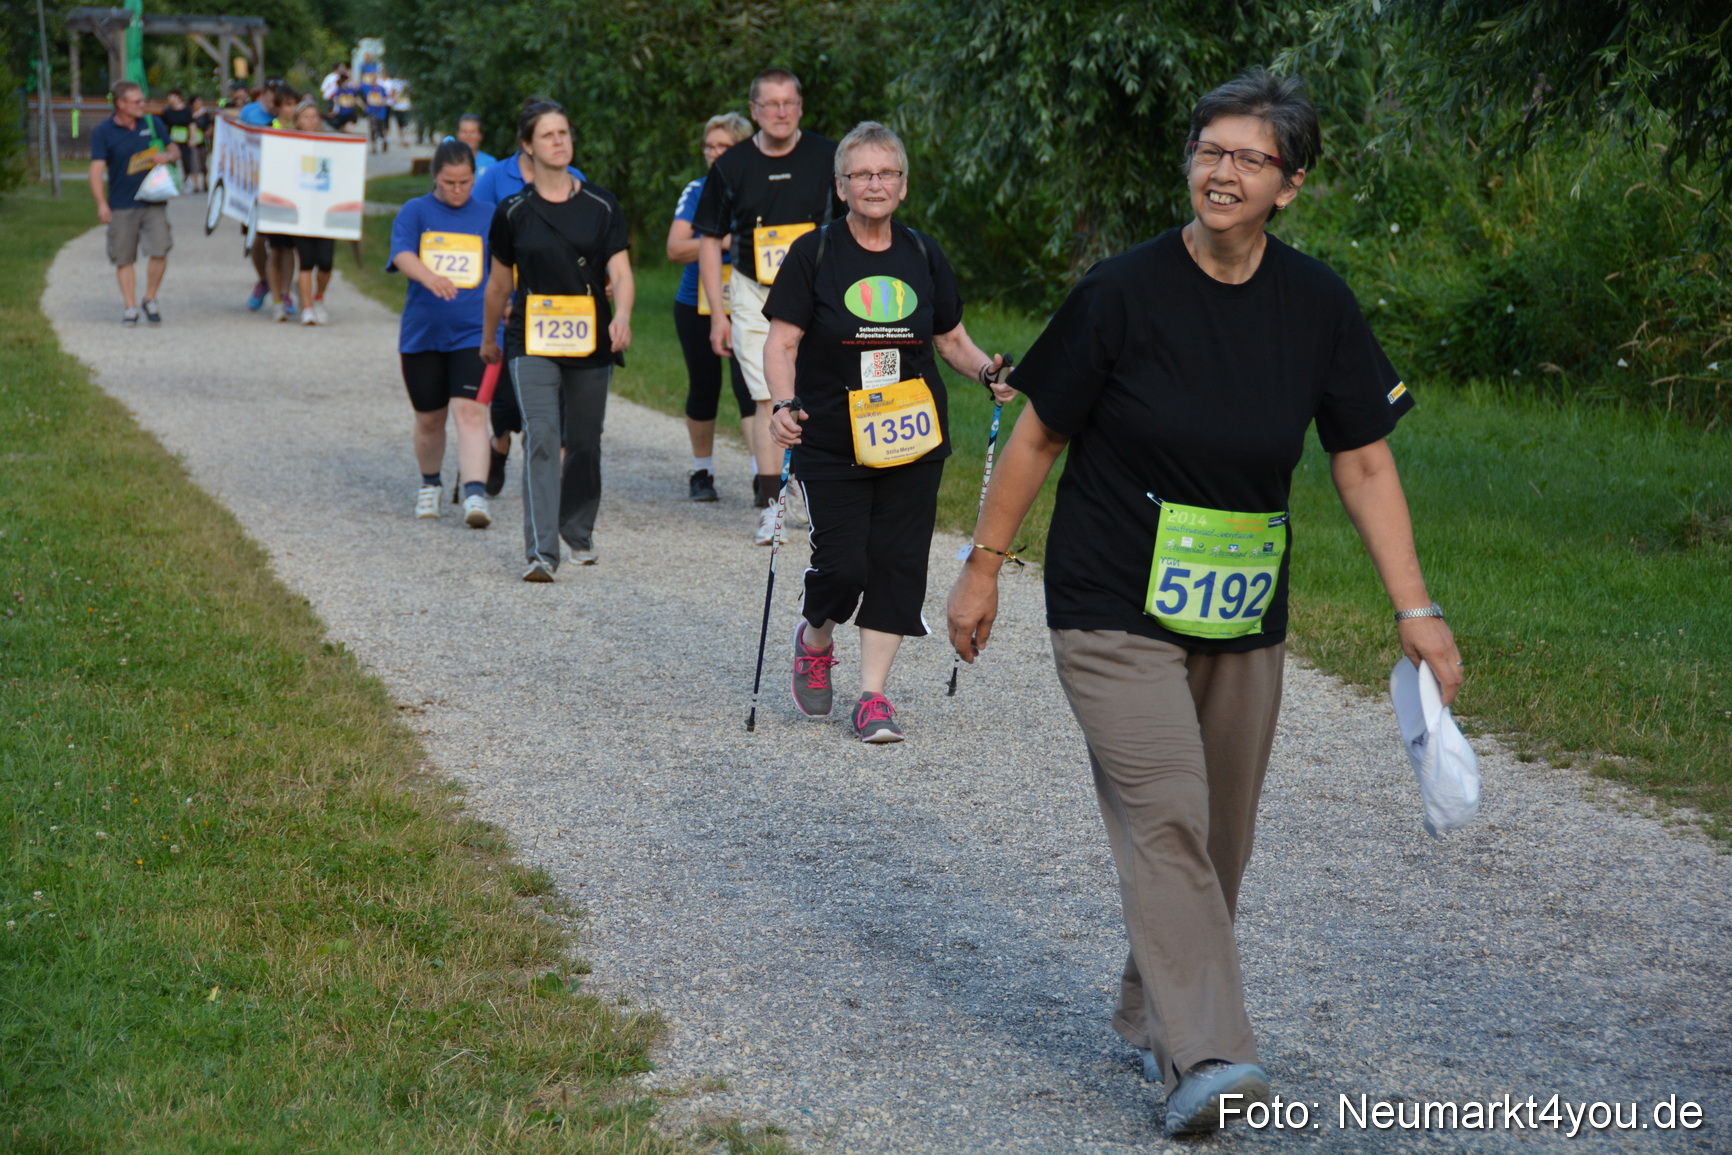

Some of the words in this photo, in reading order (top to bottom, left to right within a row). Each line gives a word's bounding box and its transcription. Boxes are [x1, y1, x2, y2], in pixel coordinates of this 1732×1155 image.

[433, 255, 470, 273] 722
[534, 320, 588, 339] 1230
[863, 411, 931, 447] 1350
[1167, 511, 1208, 527] 2014
[1155, 567, 1272, 620] 5192
